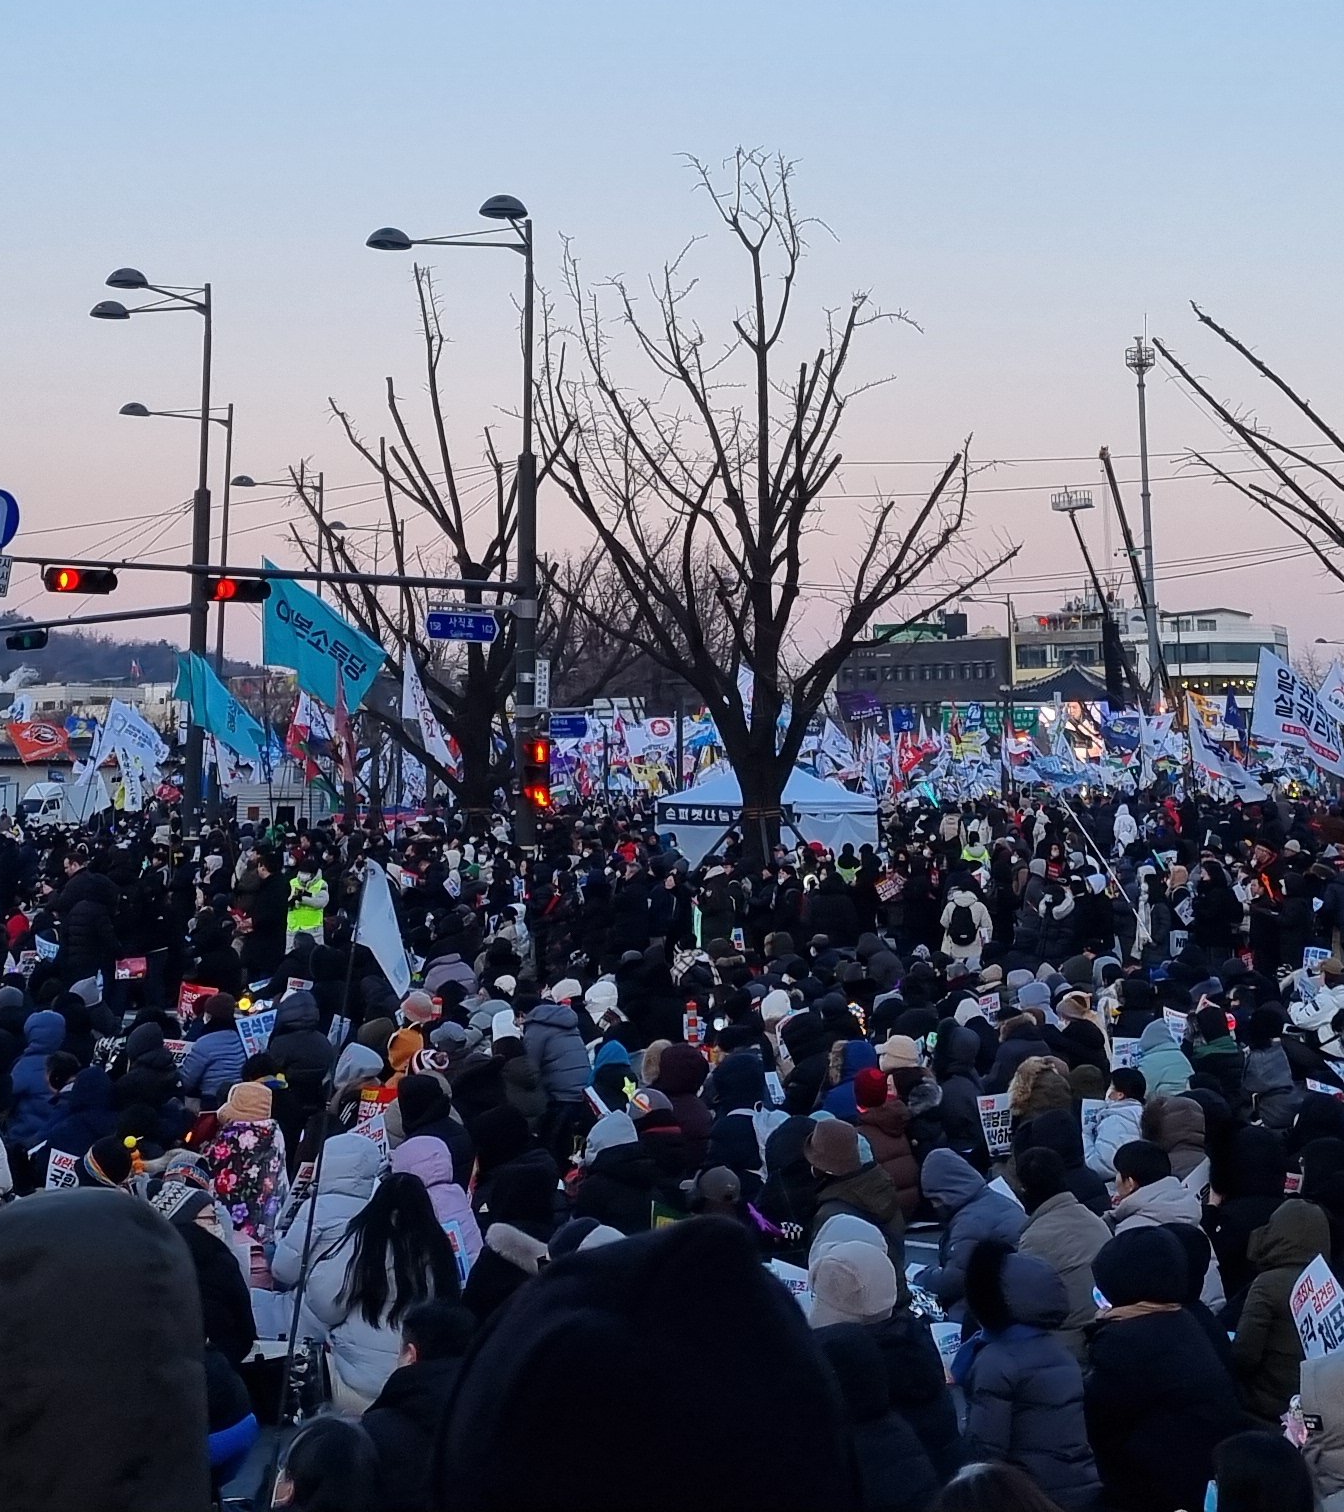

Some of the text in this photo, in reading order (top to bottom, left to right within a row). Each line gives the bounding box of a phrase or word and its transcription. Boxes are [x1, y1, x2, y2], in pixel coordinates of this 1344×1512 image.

[449, 617, 475, 628] 사직로
[52, 1154, 75, 1171] 내란
[49, 1168, 76, 1188] 국힘
[1313, 1278, 1337, 1316] 김건희
